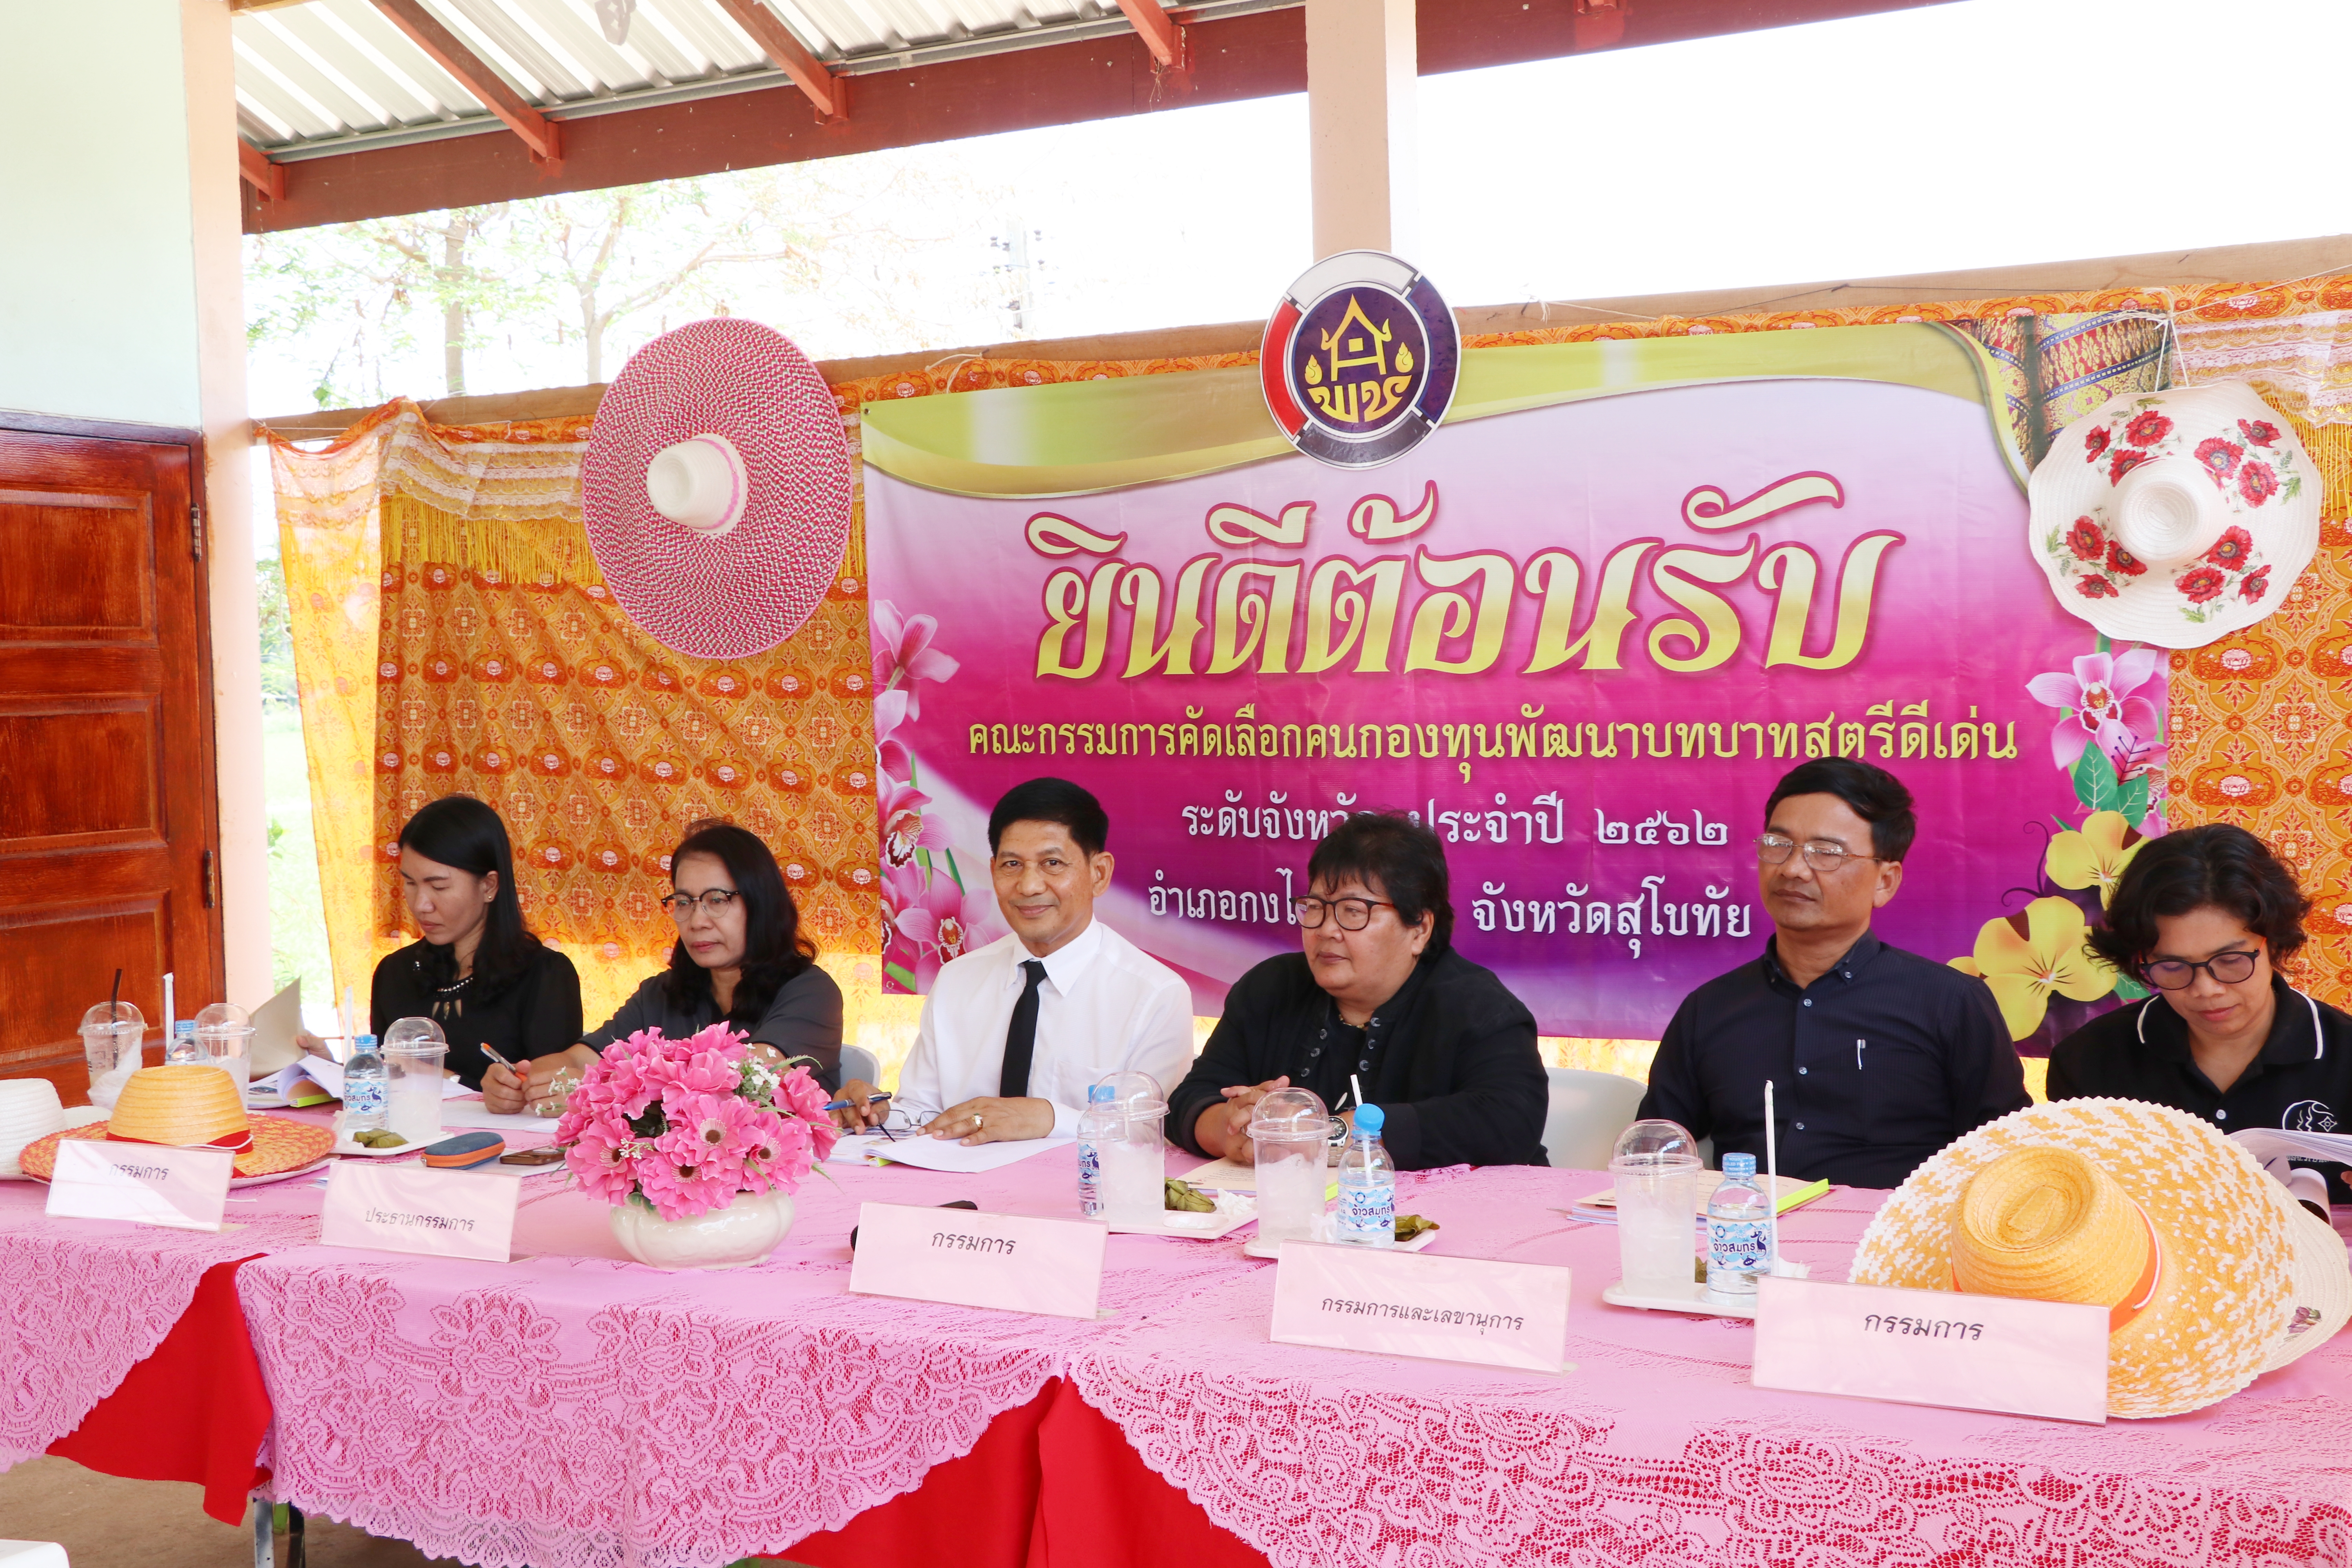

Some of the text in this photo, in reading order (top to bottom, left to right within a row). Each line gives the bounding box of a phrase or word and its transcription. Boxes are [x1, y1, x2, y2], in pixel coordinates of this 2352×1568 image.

[1025, 471, 1906, 681] ยินดีต้อนรับ
[969, 699, 2018, 784] คณะกรรมการคัดเลือกคนกองทุนพัฒนาบทบาทสตรีดีเด่น
[1181, 789, 1376, 840] ระดับจังหวั
[1594, 808, 1728, 846] ๒๕๖๒
[1148, 867, 1751, 959] อำเภอกงไ จังหวัดสุโขทัย
[109, 1163, 169, 1180] กรรมการ
[365, 1207, 475, 1232] ประธานกรรมการ
[931, 1231, 1016, 1255] กรรมการ
[1321, 1298, 1524, 1335] กรรมการและเลขานุการ
[1864, 1312, 1984, 1341] กรรมการ
